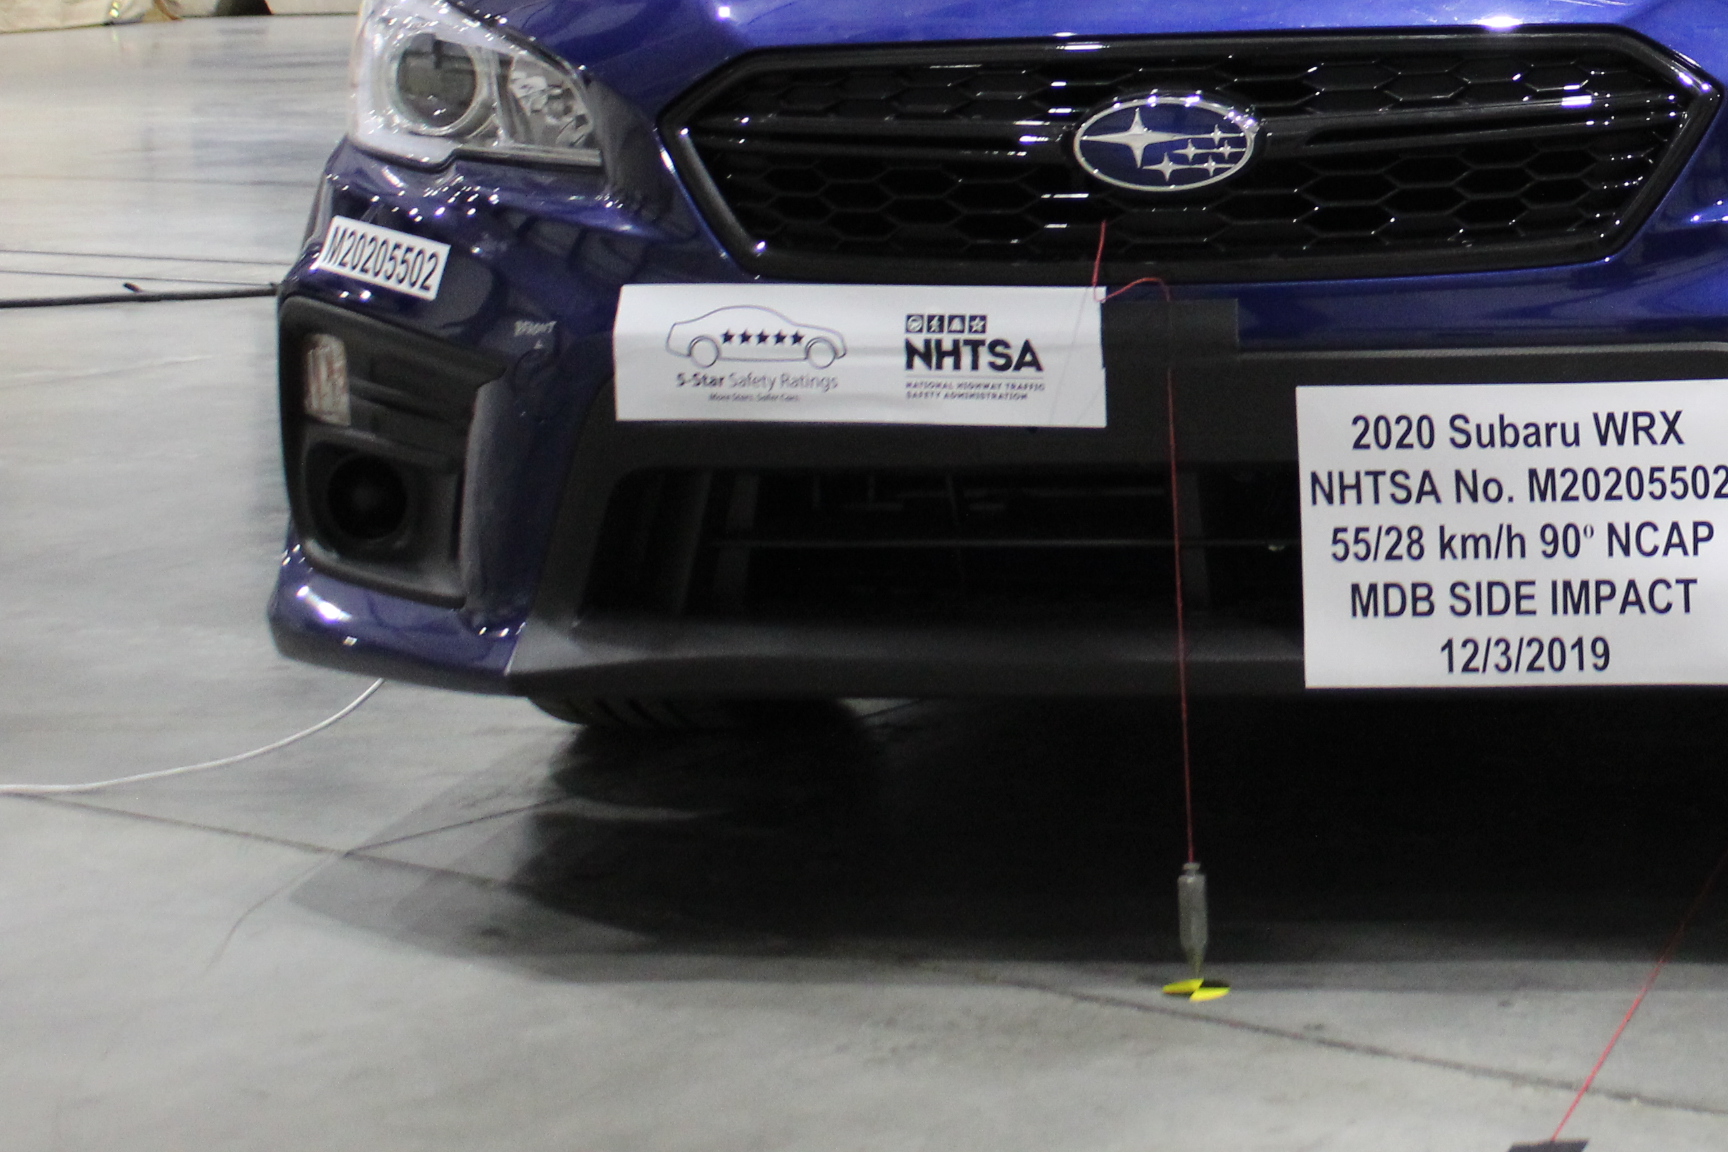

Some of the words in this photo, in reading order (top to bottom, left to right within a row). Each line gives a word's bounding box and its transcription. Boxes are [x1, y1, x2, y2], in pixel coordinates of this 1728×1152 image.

[323, 225, 441, 291] M20205502
[905, 338, 1044, 372] NHTSA
[676, 372, 726, 388] 5-Star
[728, 371, 776, 391] Safety
[779, 373, 839, 393] Ratings
[1351, 414, 1435, 450] 2020
[1449, 413, 1581, 448] Subaru
[1593, 410, 1685, 447] WRX
[1310, 470, 1442, 506] NHTSA
[1454, 469, 1515, 504] No.
[1331, 525, 1425, 562] 55/28
[1439, 524, 1527, 561] km/h
[1607, 521, 1715, 557] NCAP
[1350, 582, 1435, 618] MDB
[1449, 580, 1537, 617] SIDE
[1551, 578, 1698, 615] IMPACT
[1440, 636, 1611, 674] 12/3/2019
